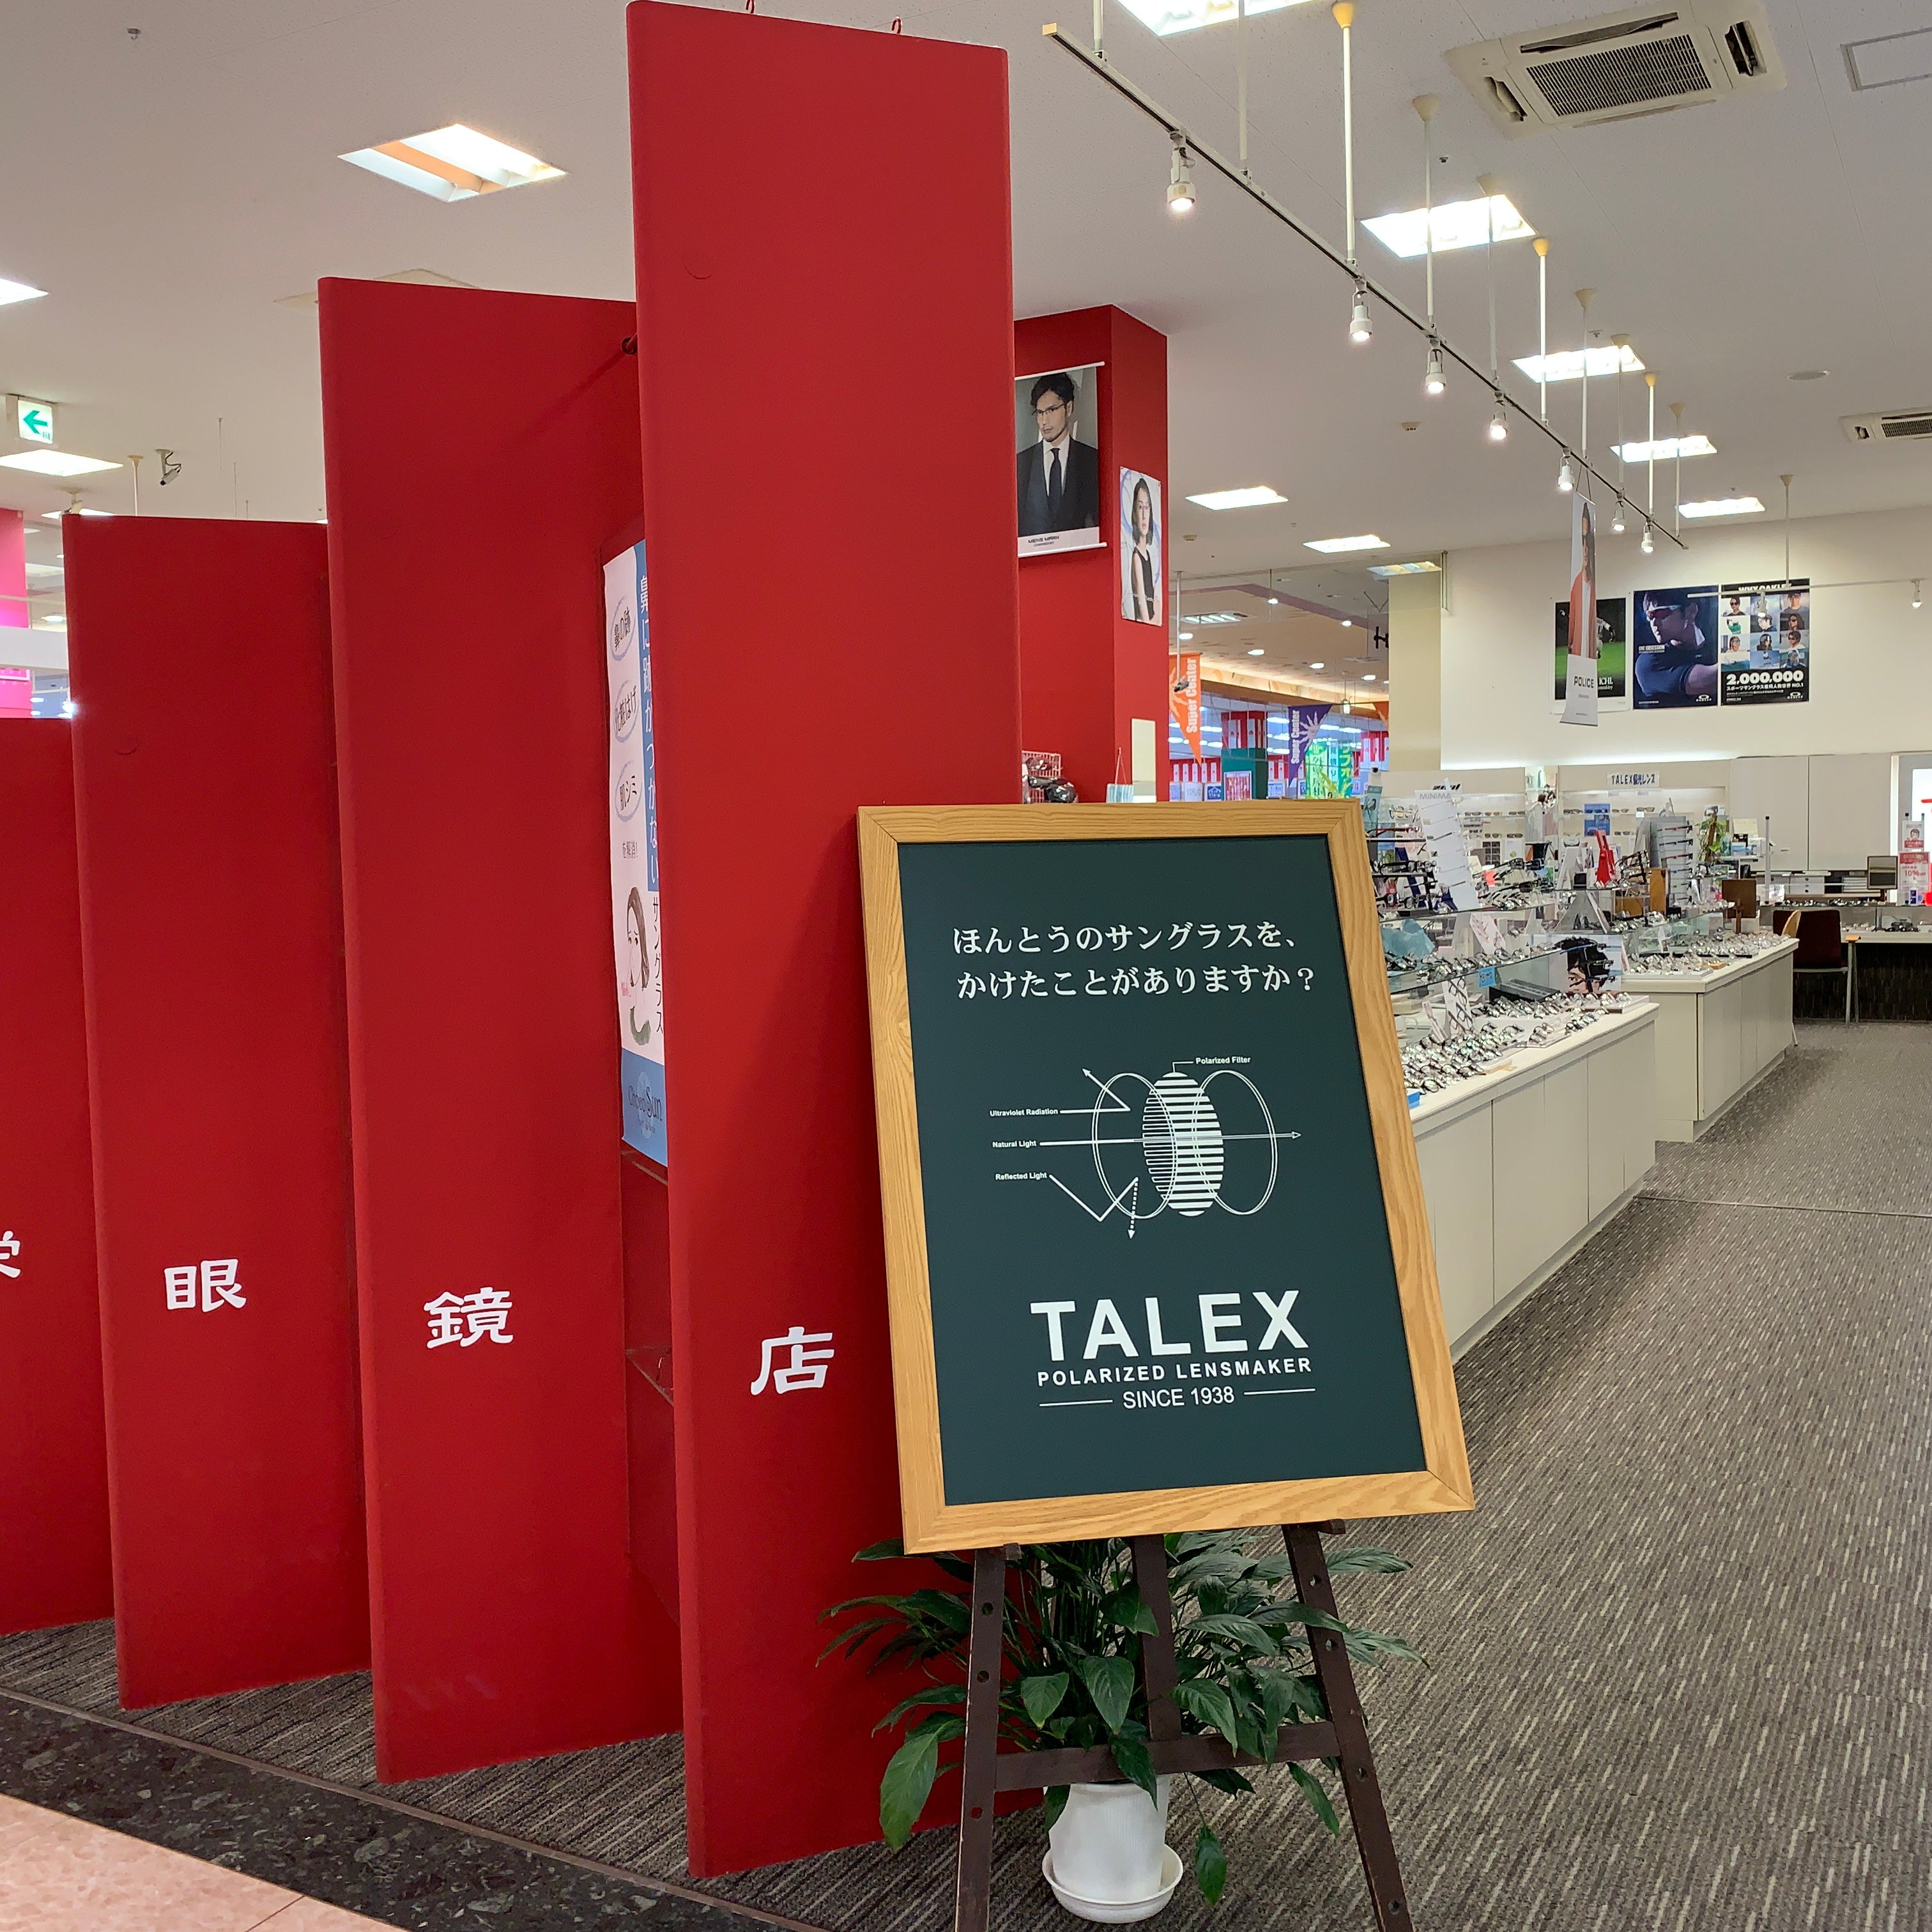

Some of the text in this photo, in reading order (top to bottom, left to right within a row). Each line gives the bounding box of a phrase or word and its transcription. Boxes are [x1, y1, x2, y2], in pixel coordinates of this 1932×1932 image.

[1574, 675, 1594, 689] POLICE
[1726, 670, 1804, 686] 2,000,000
[1186, 658, 1198, 733] Super Center
[1291, 710, 1300, 764] Super Center
[953, 921, 1295, 954] ほんとうのサングラスを、
[957, 964, 1314, 999] かけたことがありますか？
[1195, 1055, 1251, 1064] Polarized Filter
[1018, 1140, 1037, 1149] Light
[995, 1172, 1048, 1181] Reflected Light
[164, 1259, 835, 1395] 眼 鏡 店
[1030, 1290, 1310, 1361] TALEX
[1038, 1358, 1312, 1387] POLARIZED LENSMAKER
[1123, 1386, 1236, 1409] SINCE 1938
